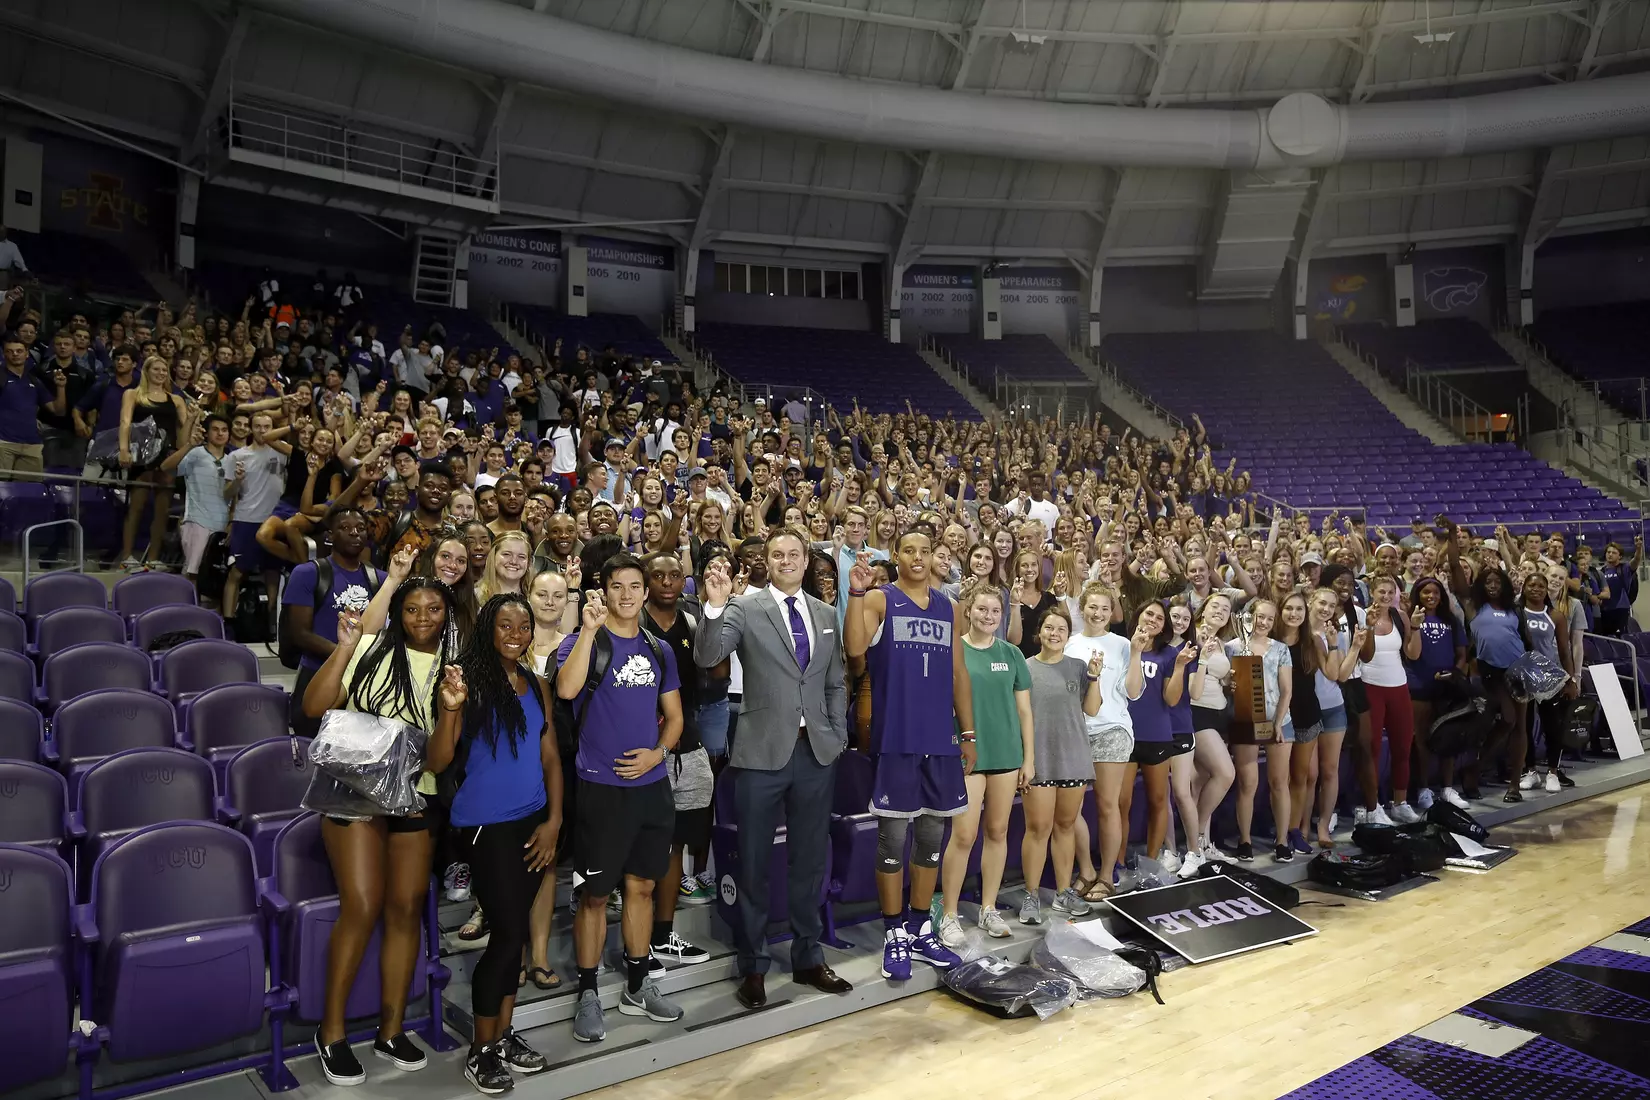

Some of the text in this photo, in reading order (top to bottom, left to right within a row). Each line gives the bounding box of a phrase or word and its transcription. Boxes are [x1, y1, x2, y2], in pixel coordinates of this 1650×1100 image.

[60, 188, 148, 226] STATE
[475, 234, 559, 254] WOMEN'S CONF.
[469, 252, 558, 273] 001 2002 2003
[617, 271, 640, 281] 2010
[914, 275, 958, 285] WOMEN'S
[922, 293, 944, 302] 2002
[951, 293, 973, 301] 2003
[1026, 295, 1049, 304] 2005
[906, 620, 944, 641] TCU
[922, 652, 929, 677] 1
[723, 883, 735, 896] TCU
[1147, 896, 1272, 935] RIFLE
